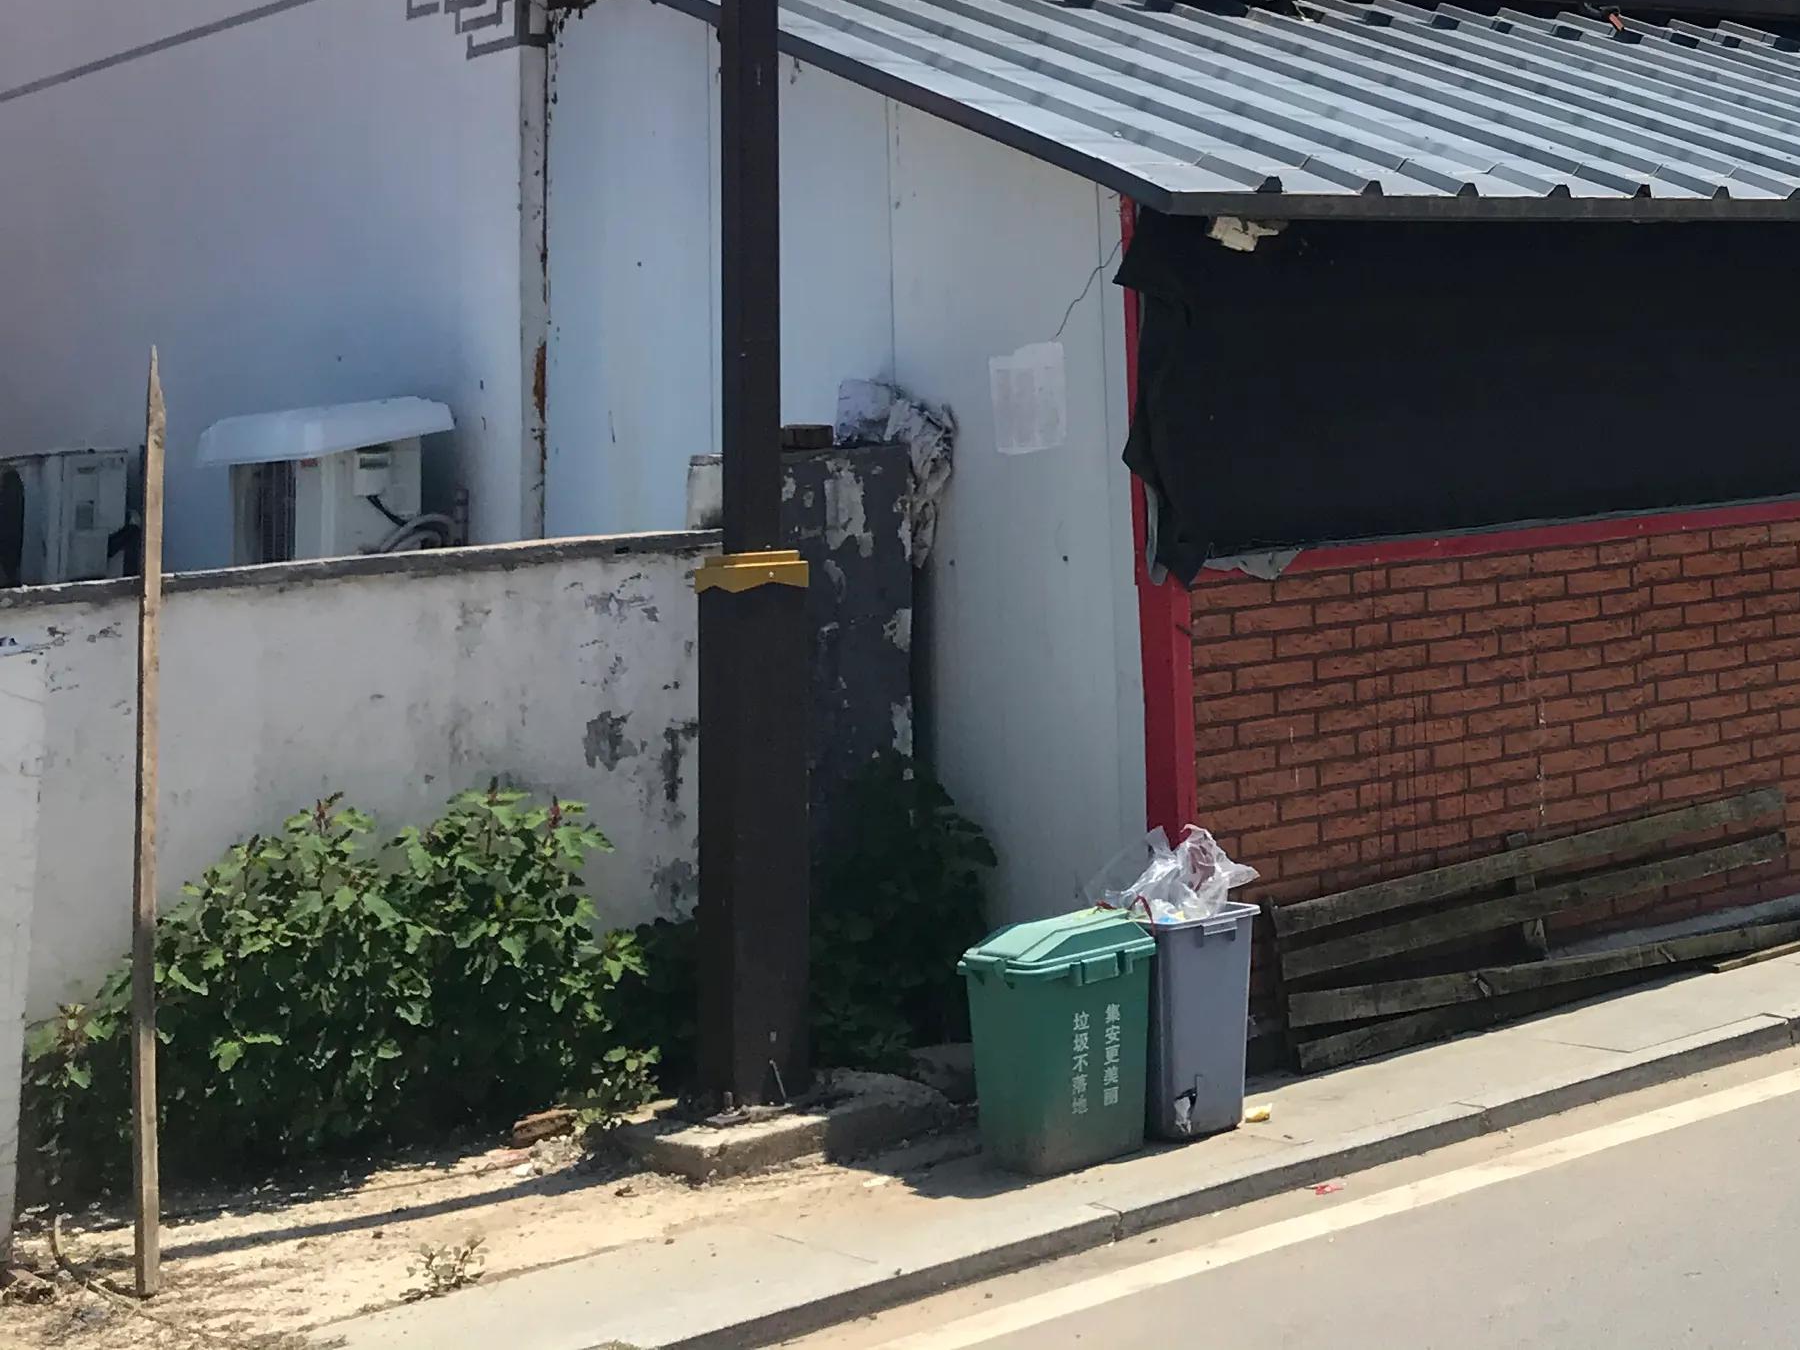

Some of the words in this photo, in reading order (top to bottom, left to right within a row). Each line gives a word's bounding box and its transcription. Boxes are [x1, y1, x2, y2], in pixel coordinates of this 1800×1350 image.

[1102, 1002, 1122, 1107] 集安更美丽
